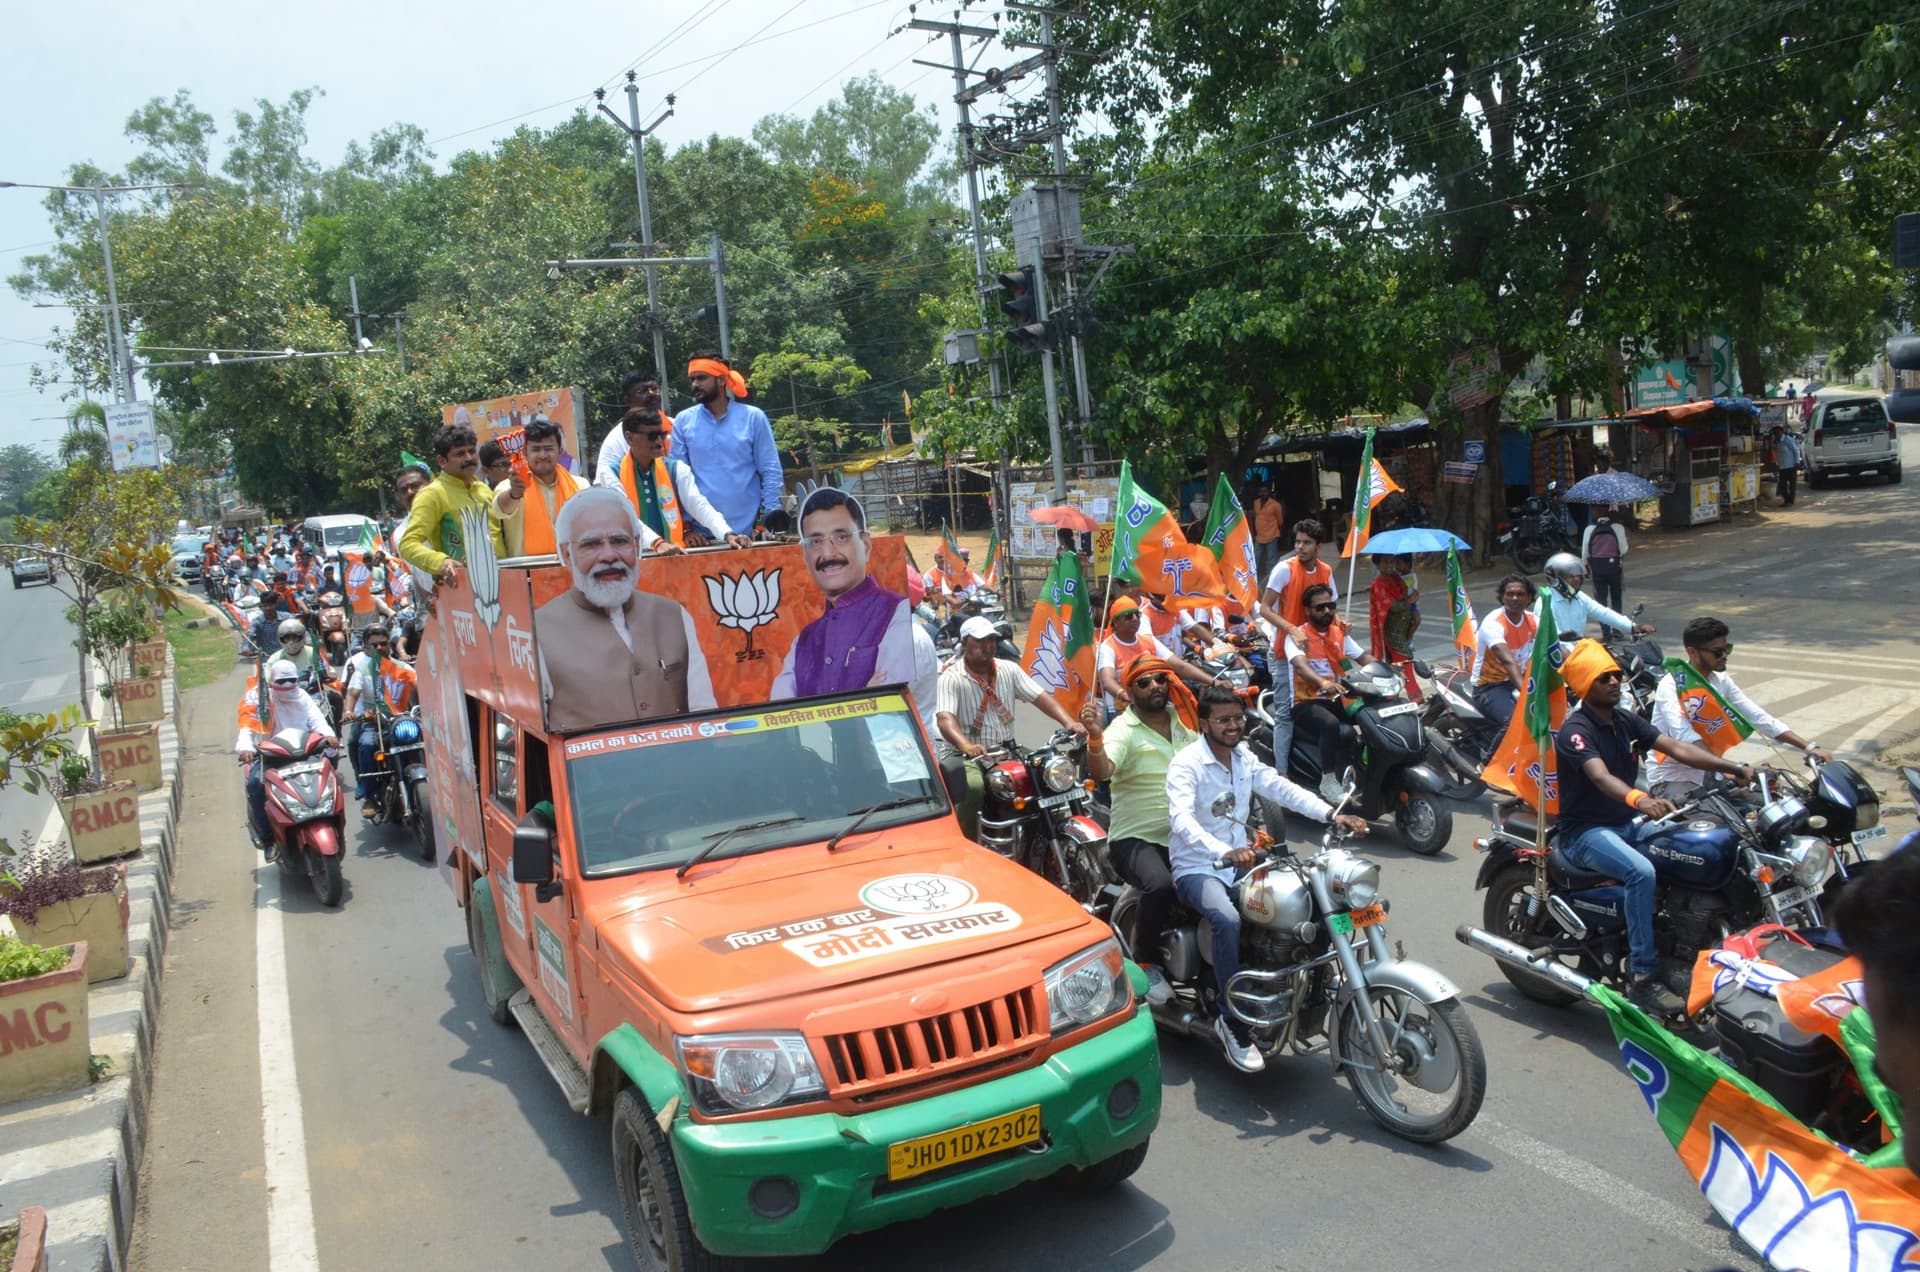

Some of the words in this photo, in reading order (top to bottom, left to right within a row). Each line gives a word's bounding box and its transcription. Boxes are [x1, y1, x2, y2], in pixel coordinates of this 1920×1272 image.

[452, 609, 477, 657] चुनाव
[506, 614, 536, 682] चिन्ह
[567, 736, 605, 754] कमल
[608, 734, 625, 747] का
[763, 709, 815, 727] विकसित
[816, 704, 846, 721] भारत
[1570, 733, 1586, 752] 3
[724, 926, 782, 950] फिर
[780, 917, 828, 937] एक
[833, 908, 877, 926] बार
[804, 925, 893, 960] मोदी
[894, 909, 1011, 941] सरकार
[907, 1113, 1039, 1170] JH01DX2302
